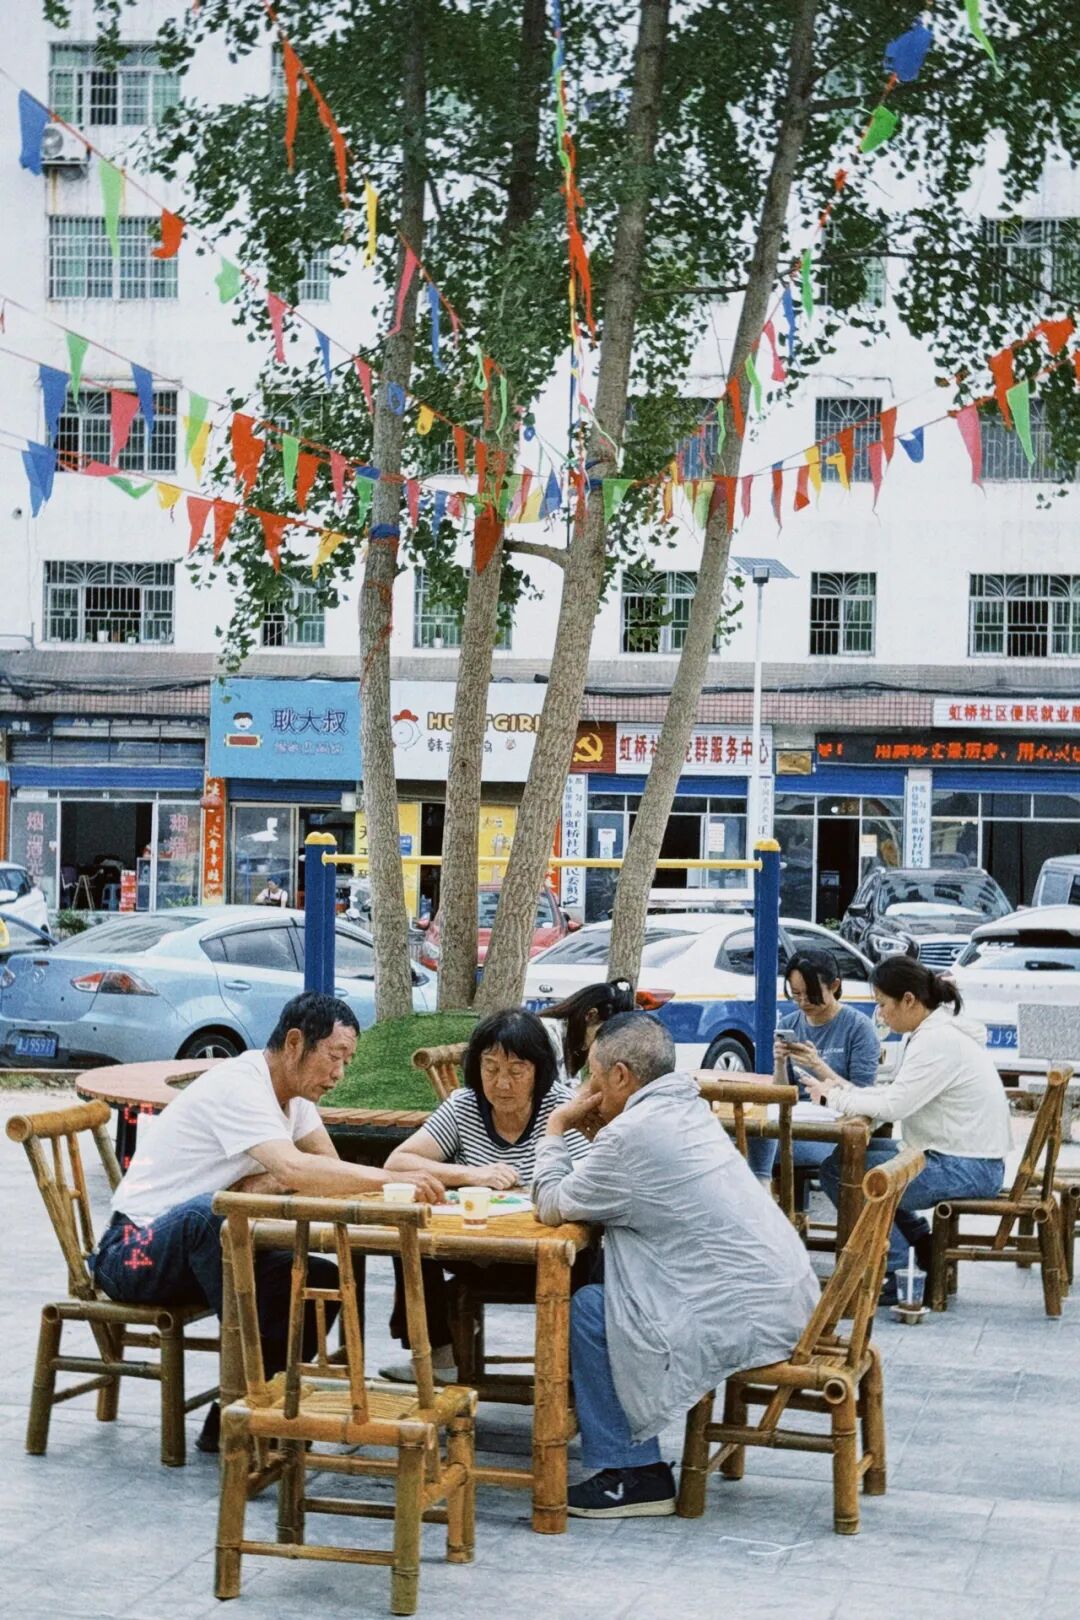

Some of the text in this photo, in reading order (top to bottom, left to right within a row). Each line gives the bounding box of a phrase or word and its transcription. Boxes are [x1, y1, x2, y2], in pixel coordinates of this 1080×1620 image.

[272, 708, 348, 736] 耿大叔
[619, 735, 769, 765] 虹桥群服务中心
